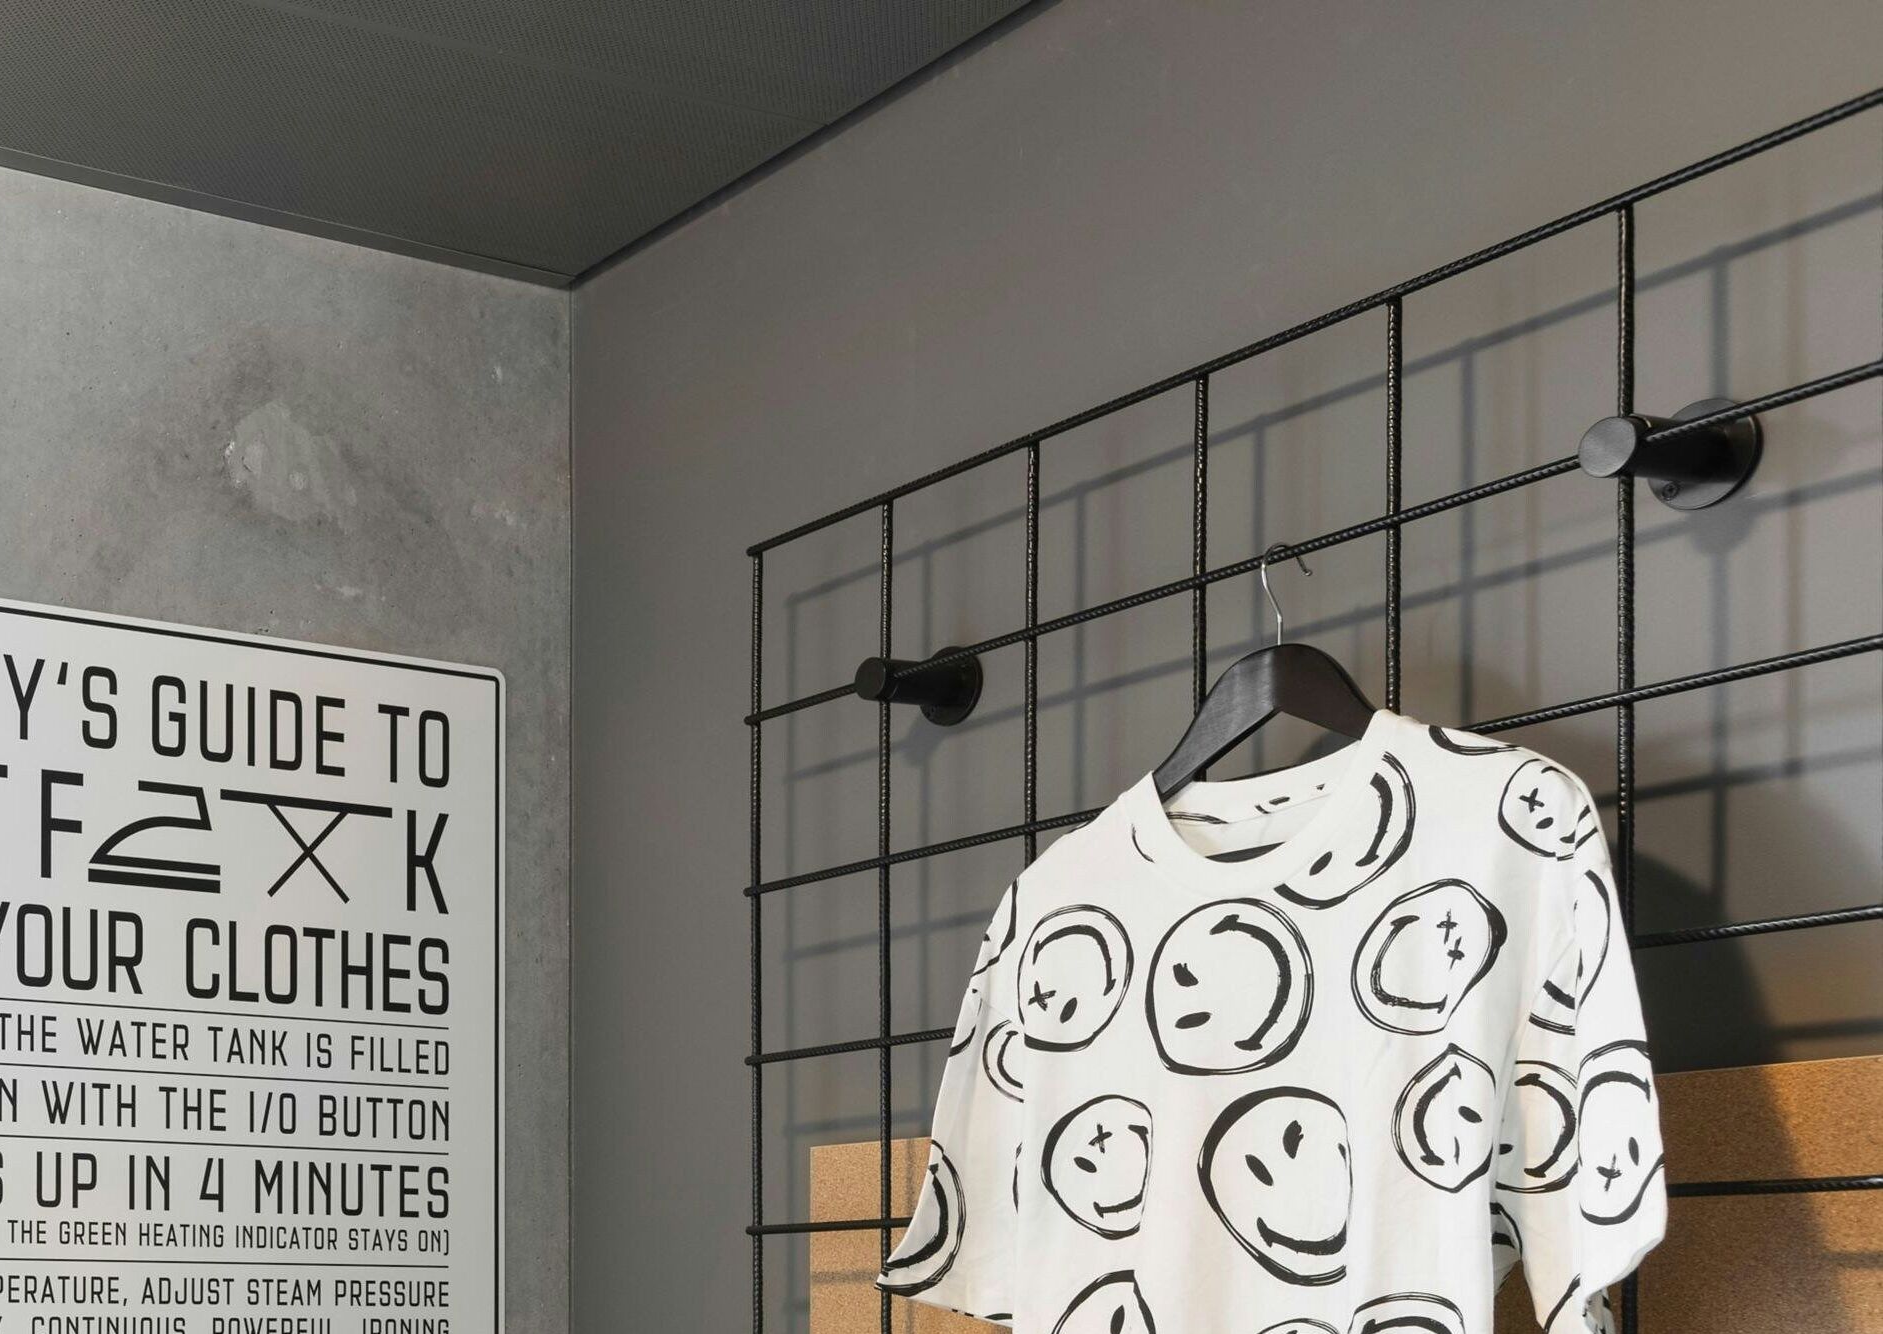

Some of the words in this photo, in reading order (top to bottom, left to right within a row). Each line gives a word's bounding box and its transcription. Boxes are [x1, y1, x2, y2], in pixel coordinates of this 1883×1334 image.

[152, 675, 345, 777] GUIDE
[378, 704, 449, 788] TO
[186, 918, 449, 1015] CLOTHES
[77, 1018, 188, 1060] WATER
[208, 1026, 287, 1066] TANK
[307, 1033, 331, 1068] IS
[351, 1035, 449, 1075] FILLED
[42, 1080, 136, 1127] WITH
[159, 1087, 226, 1131] THE
[250, 1091, 296, 1134] I/O
[319, 1095, 449, 1141] BUTTON
[37, 1152, 97, 1208] UP
[129, 1155, 169, 1211] IN
[200, 1158, 223, 1212] 4
[255, 1160, 449, 1218] MINUTES
[8, 1220, 46, 1244] THE
[60, 1221, 126, 1245] GREEN
[140, 1223, 223, 1247] HEATING
[236, 1226, 337, 1250] INDICATOR
[349, 1228, 407, 1251] STAYS
[142, 1277, 234, 1305] ADJUST
[248, 1279, 321, 1306] STEAM
[335, 1280, 449, 1307] PRESSURE
